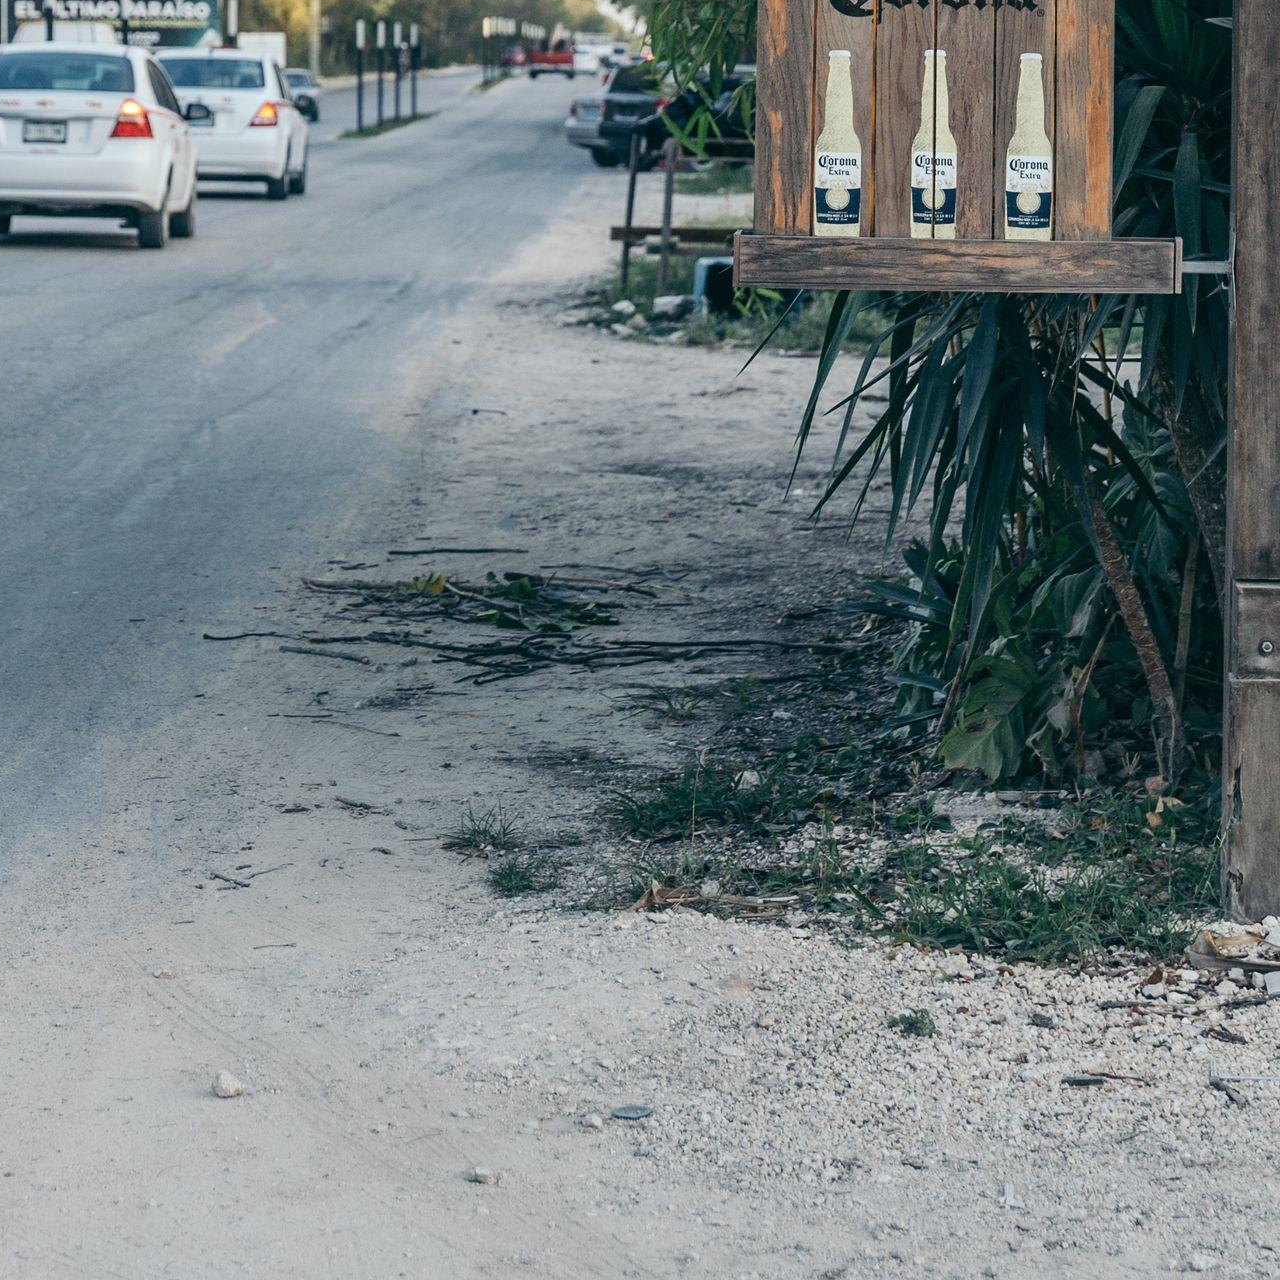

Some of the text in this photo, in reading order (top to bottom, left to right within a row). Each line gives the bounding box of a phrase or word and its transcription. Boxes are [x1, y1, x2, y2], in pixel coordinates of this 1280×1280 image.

[14, 0, 42, 19] EL
[818, 154, 859, 169] Corona
[1009, 158, 1049, 173] Corona
[828, 166, 850, 176] Extra
[1019, 170, 1041, 180] Extra
